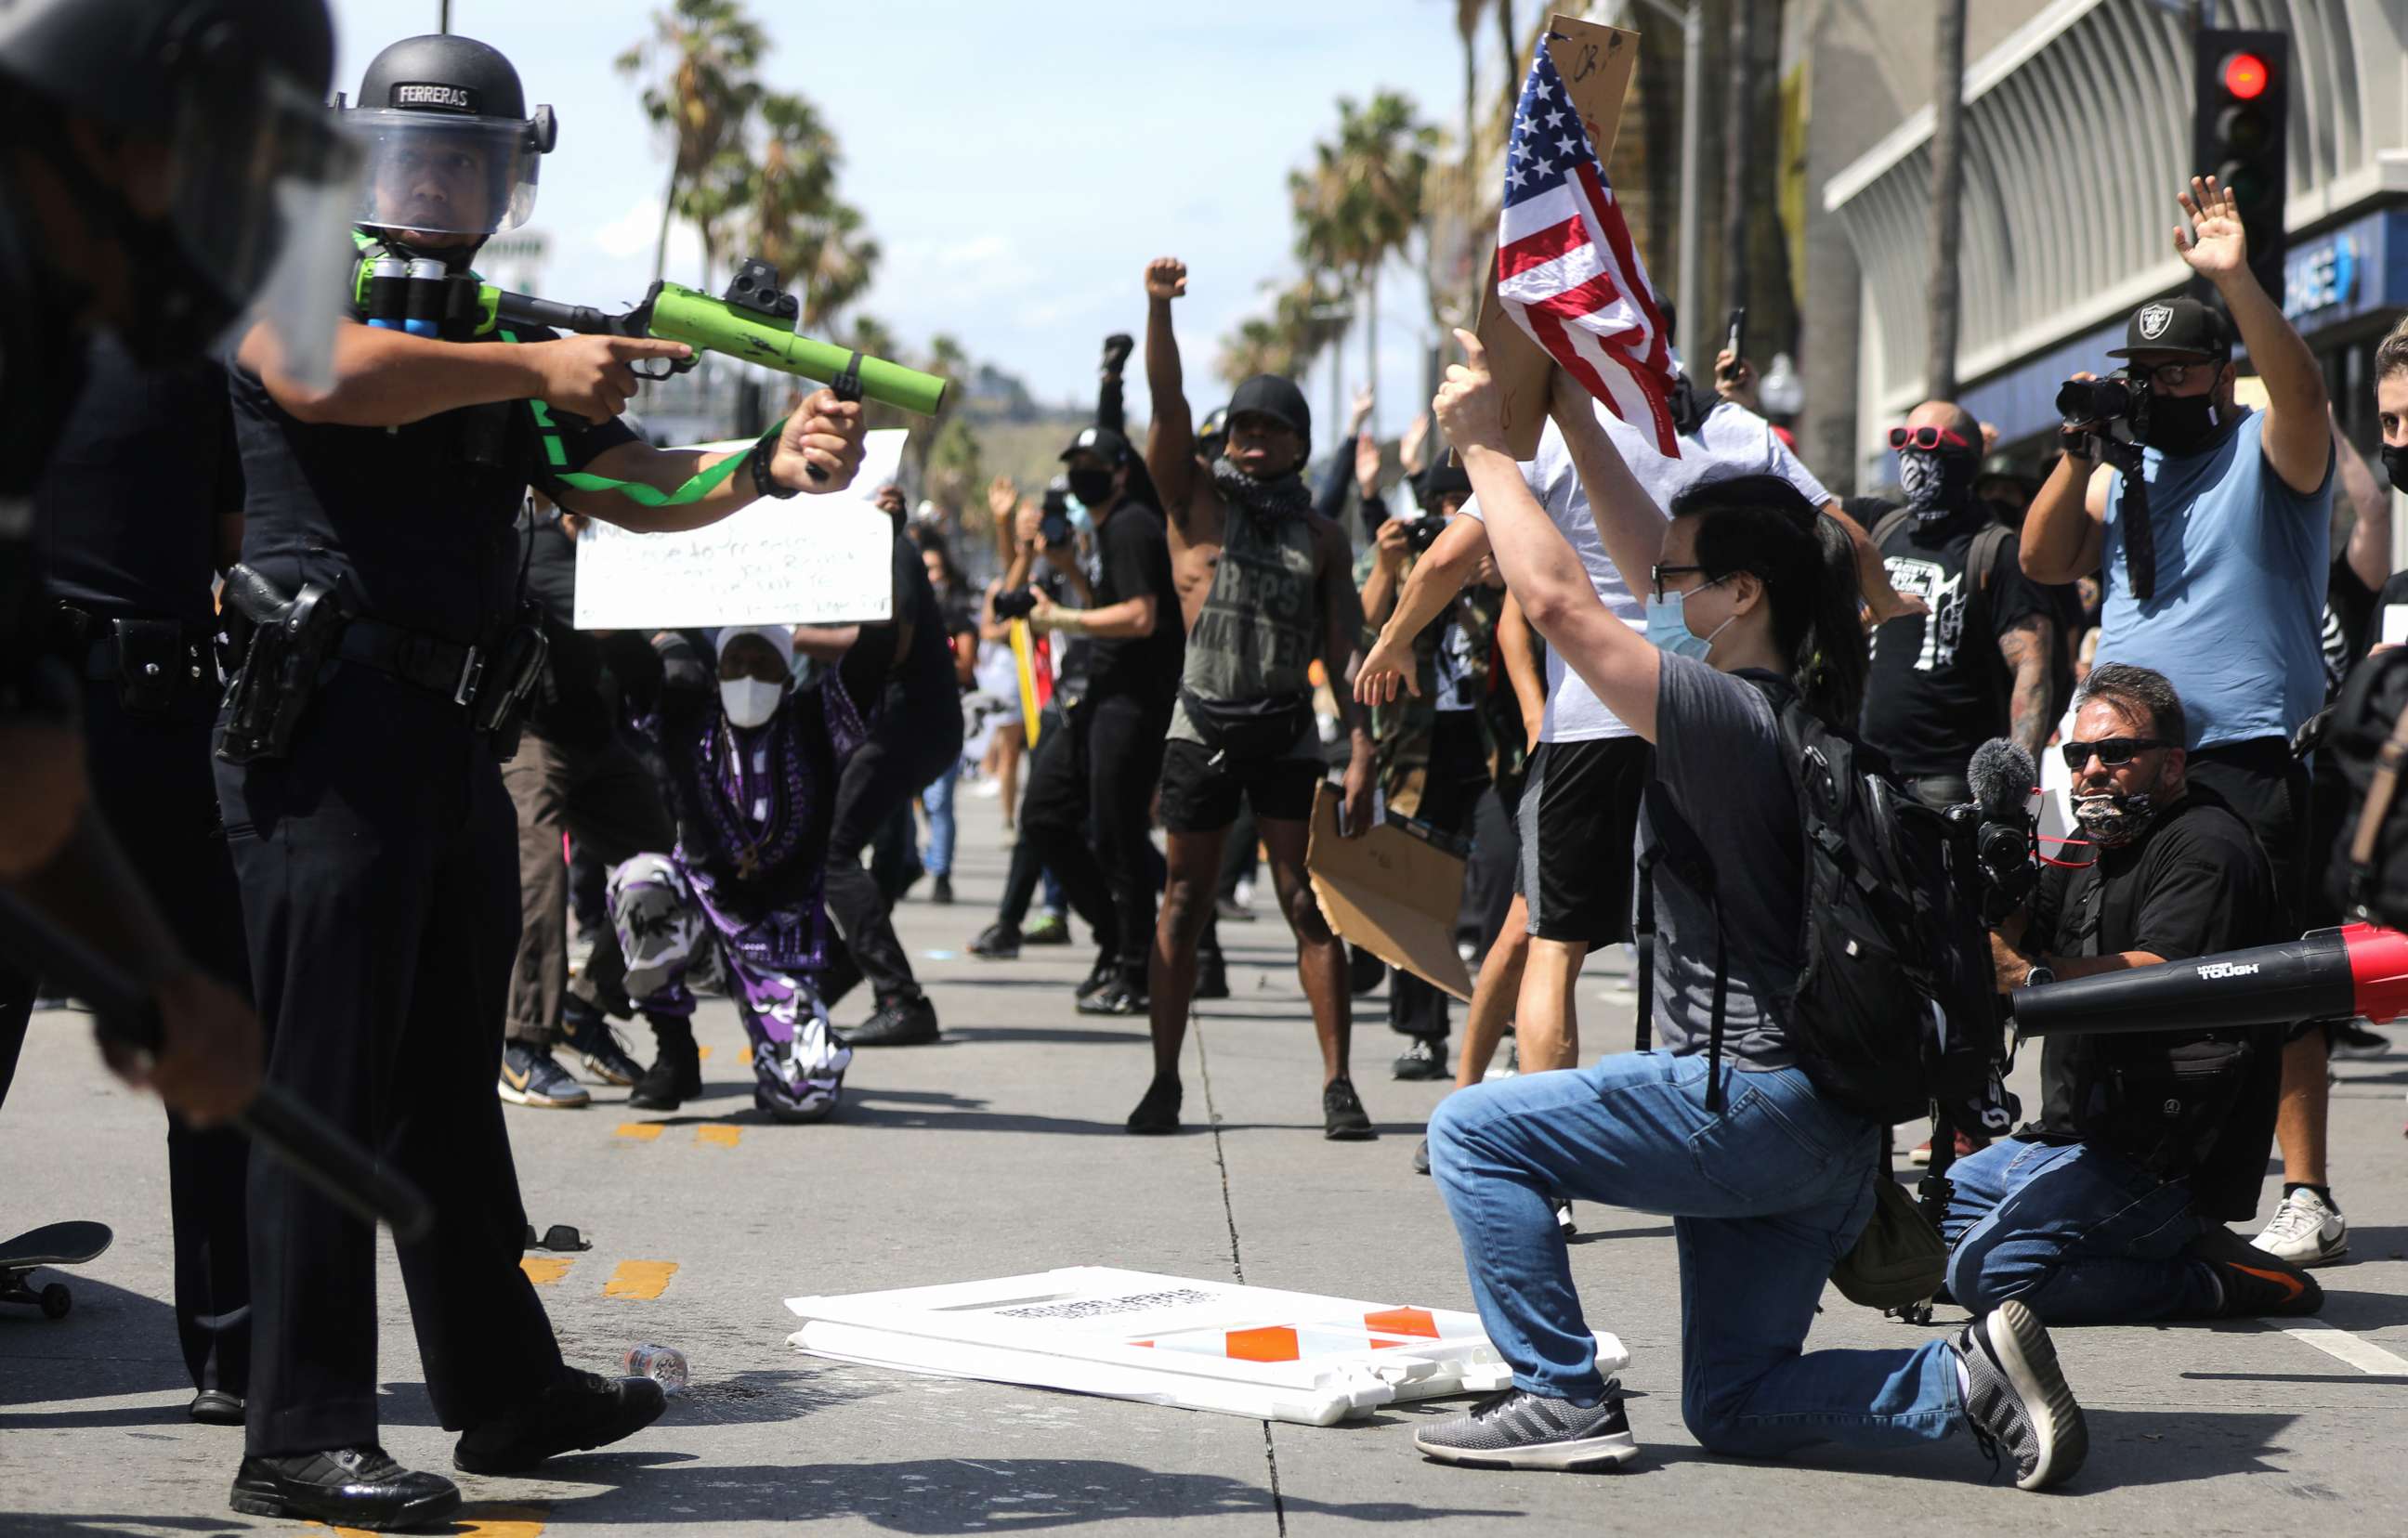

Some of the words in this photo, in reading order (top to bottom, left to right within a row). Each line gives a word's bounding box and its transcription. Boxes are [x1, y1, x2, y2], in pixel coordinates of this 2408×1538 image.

[399, 85, 468, 106] FERRERAS
[1215, 559, 1302, 618] REPS
[2196, 962, 2233, 975] HYPER
[2202, 963, 2259, 980] TOUGH
